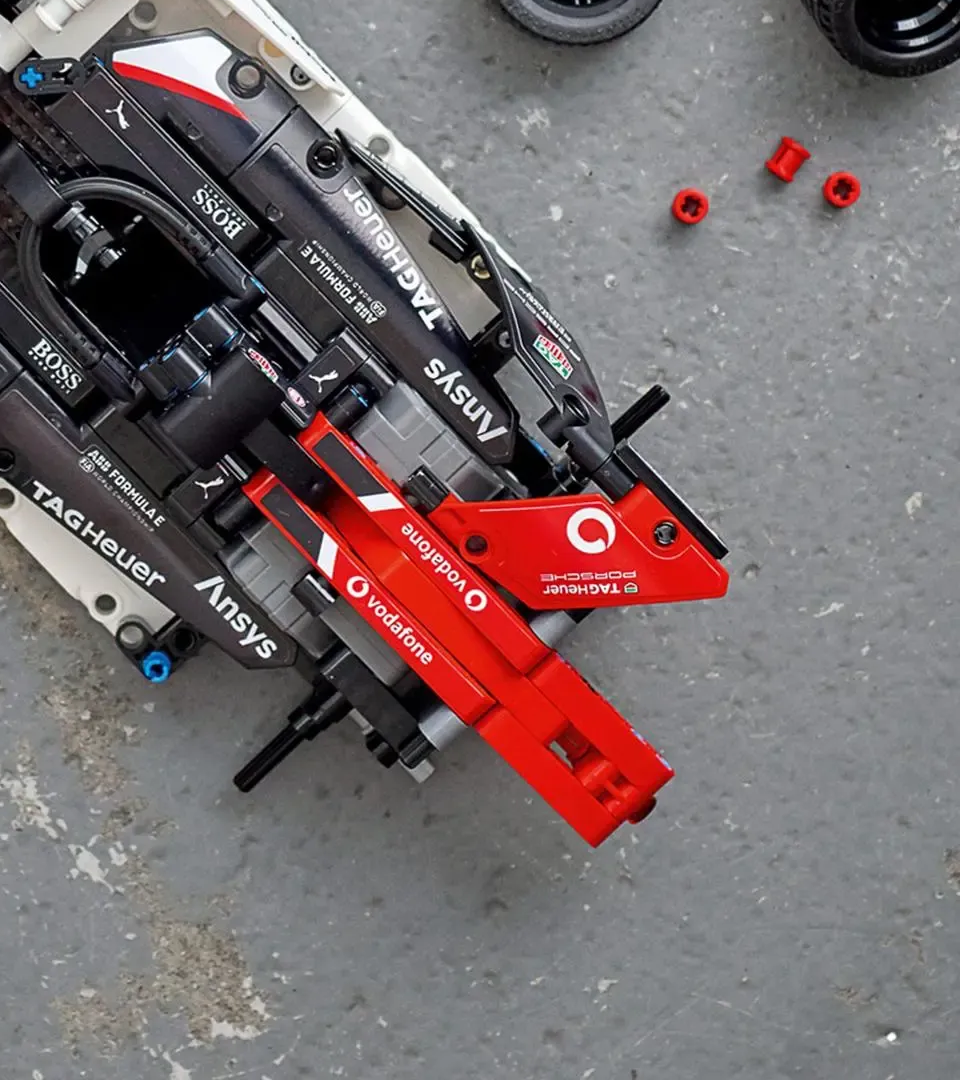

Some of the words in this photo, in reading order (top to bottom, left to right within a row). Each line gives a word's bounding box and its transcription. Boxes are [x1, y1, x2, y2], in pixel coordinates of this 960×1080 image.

[192, 188, 243, 240] BOSS
[309, 252, 357, 305] FORMULA
[353, 301, 378, 325] ABB
[32, 338, 82, 390] BOSS
[423, 357, 509, 443] Ansys
[87, 449, 112, 472] ABB
[108, 469, 157, 520] FORMULA
[401, 522, 467, 592] vodafone
[540, 570, 636, 582] PORSCHE
[194, 575, 278, 660] Ansys
[367, 595, 433, 665] vodafone
